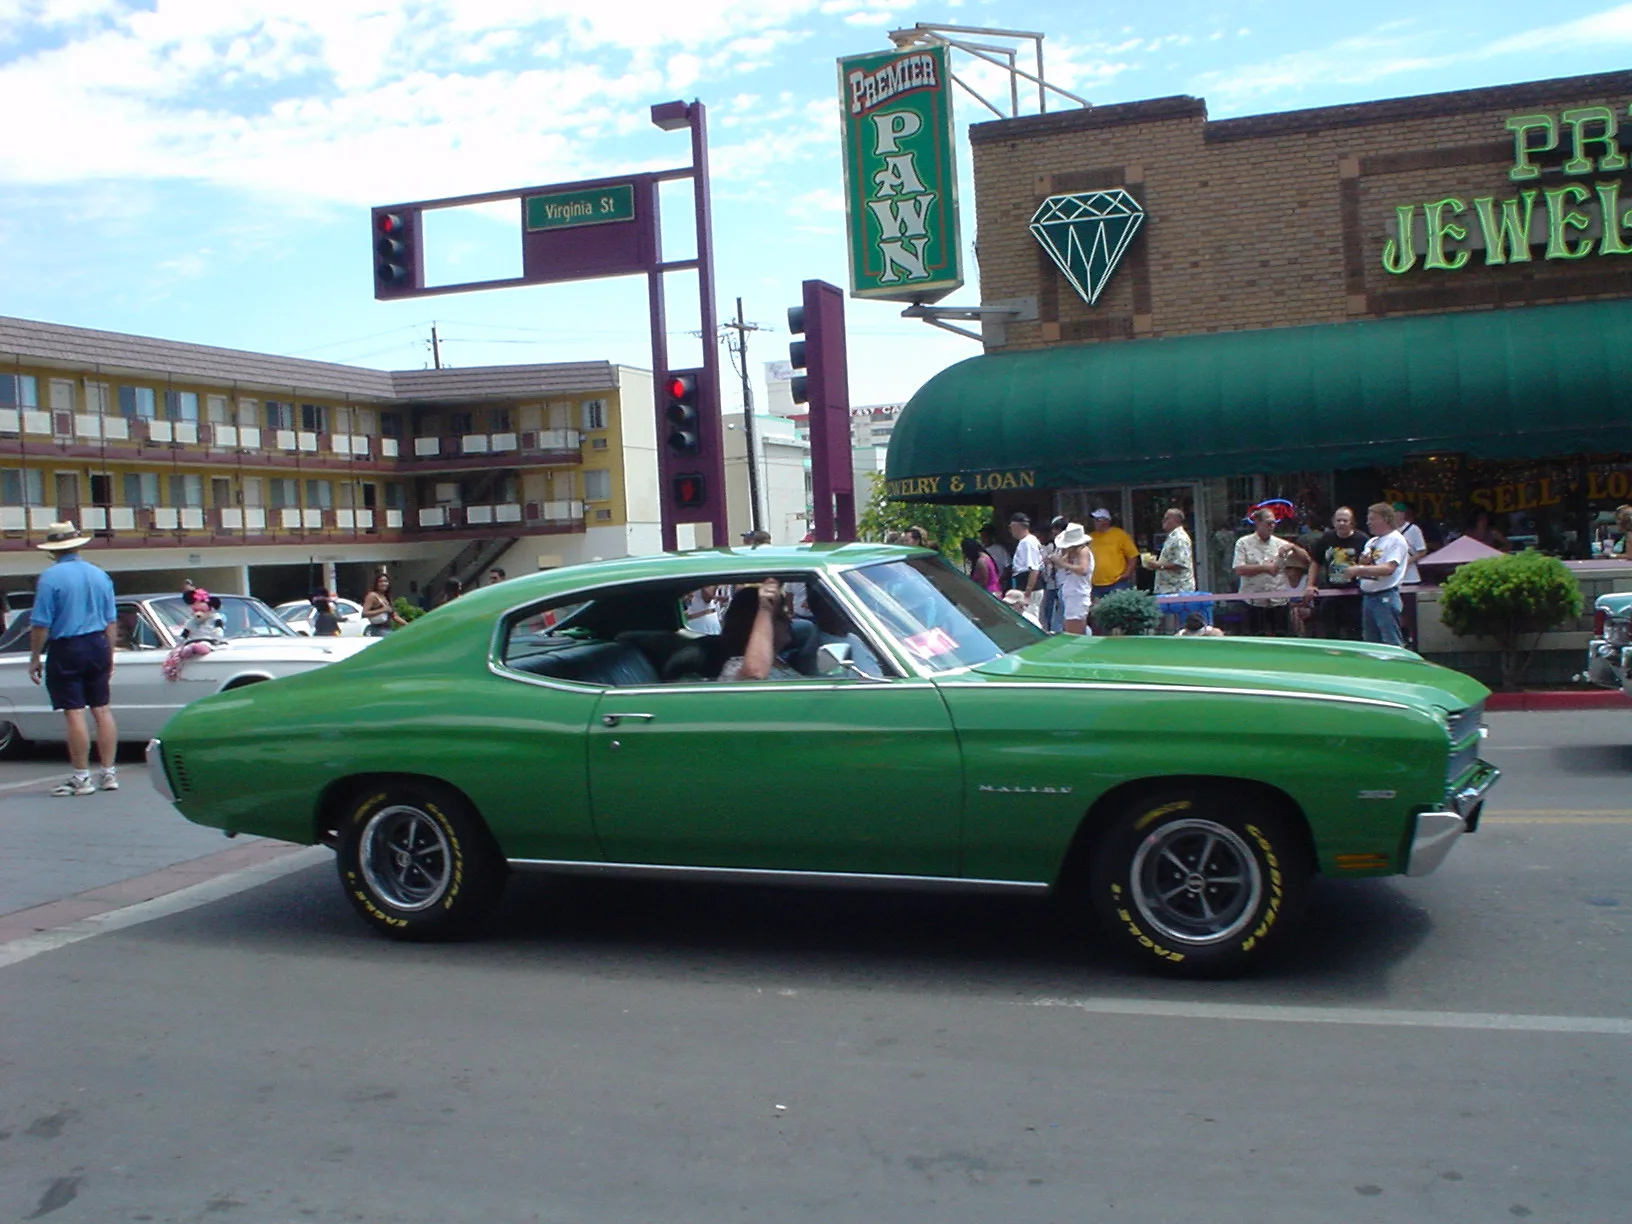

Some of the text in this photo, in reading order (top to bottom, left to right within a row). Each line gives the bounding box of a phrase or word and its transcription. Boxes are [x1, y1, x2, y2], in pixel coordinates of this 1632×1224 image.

[850, 54, 937, 115] PREMIER
[1506, 106, 1632, 180] PR
[545, 197, 614, 222] Virginia St
[867, 110, 937, 283] PAWN
[1382, 180, 1632, 274] JEWEL
[950, 475, 966, 492] &
[975, 470, 1036, 490] LOAN
[1470, 477, 1561, 514] SELL
[1586, 471, 1632, 499] LO
[1116, 907, 1186, 962] EAGLE
